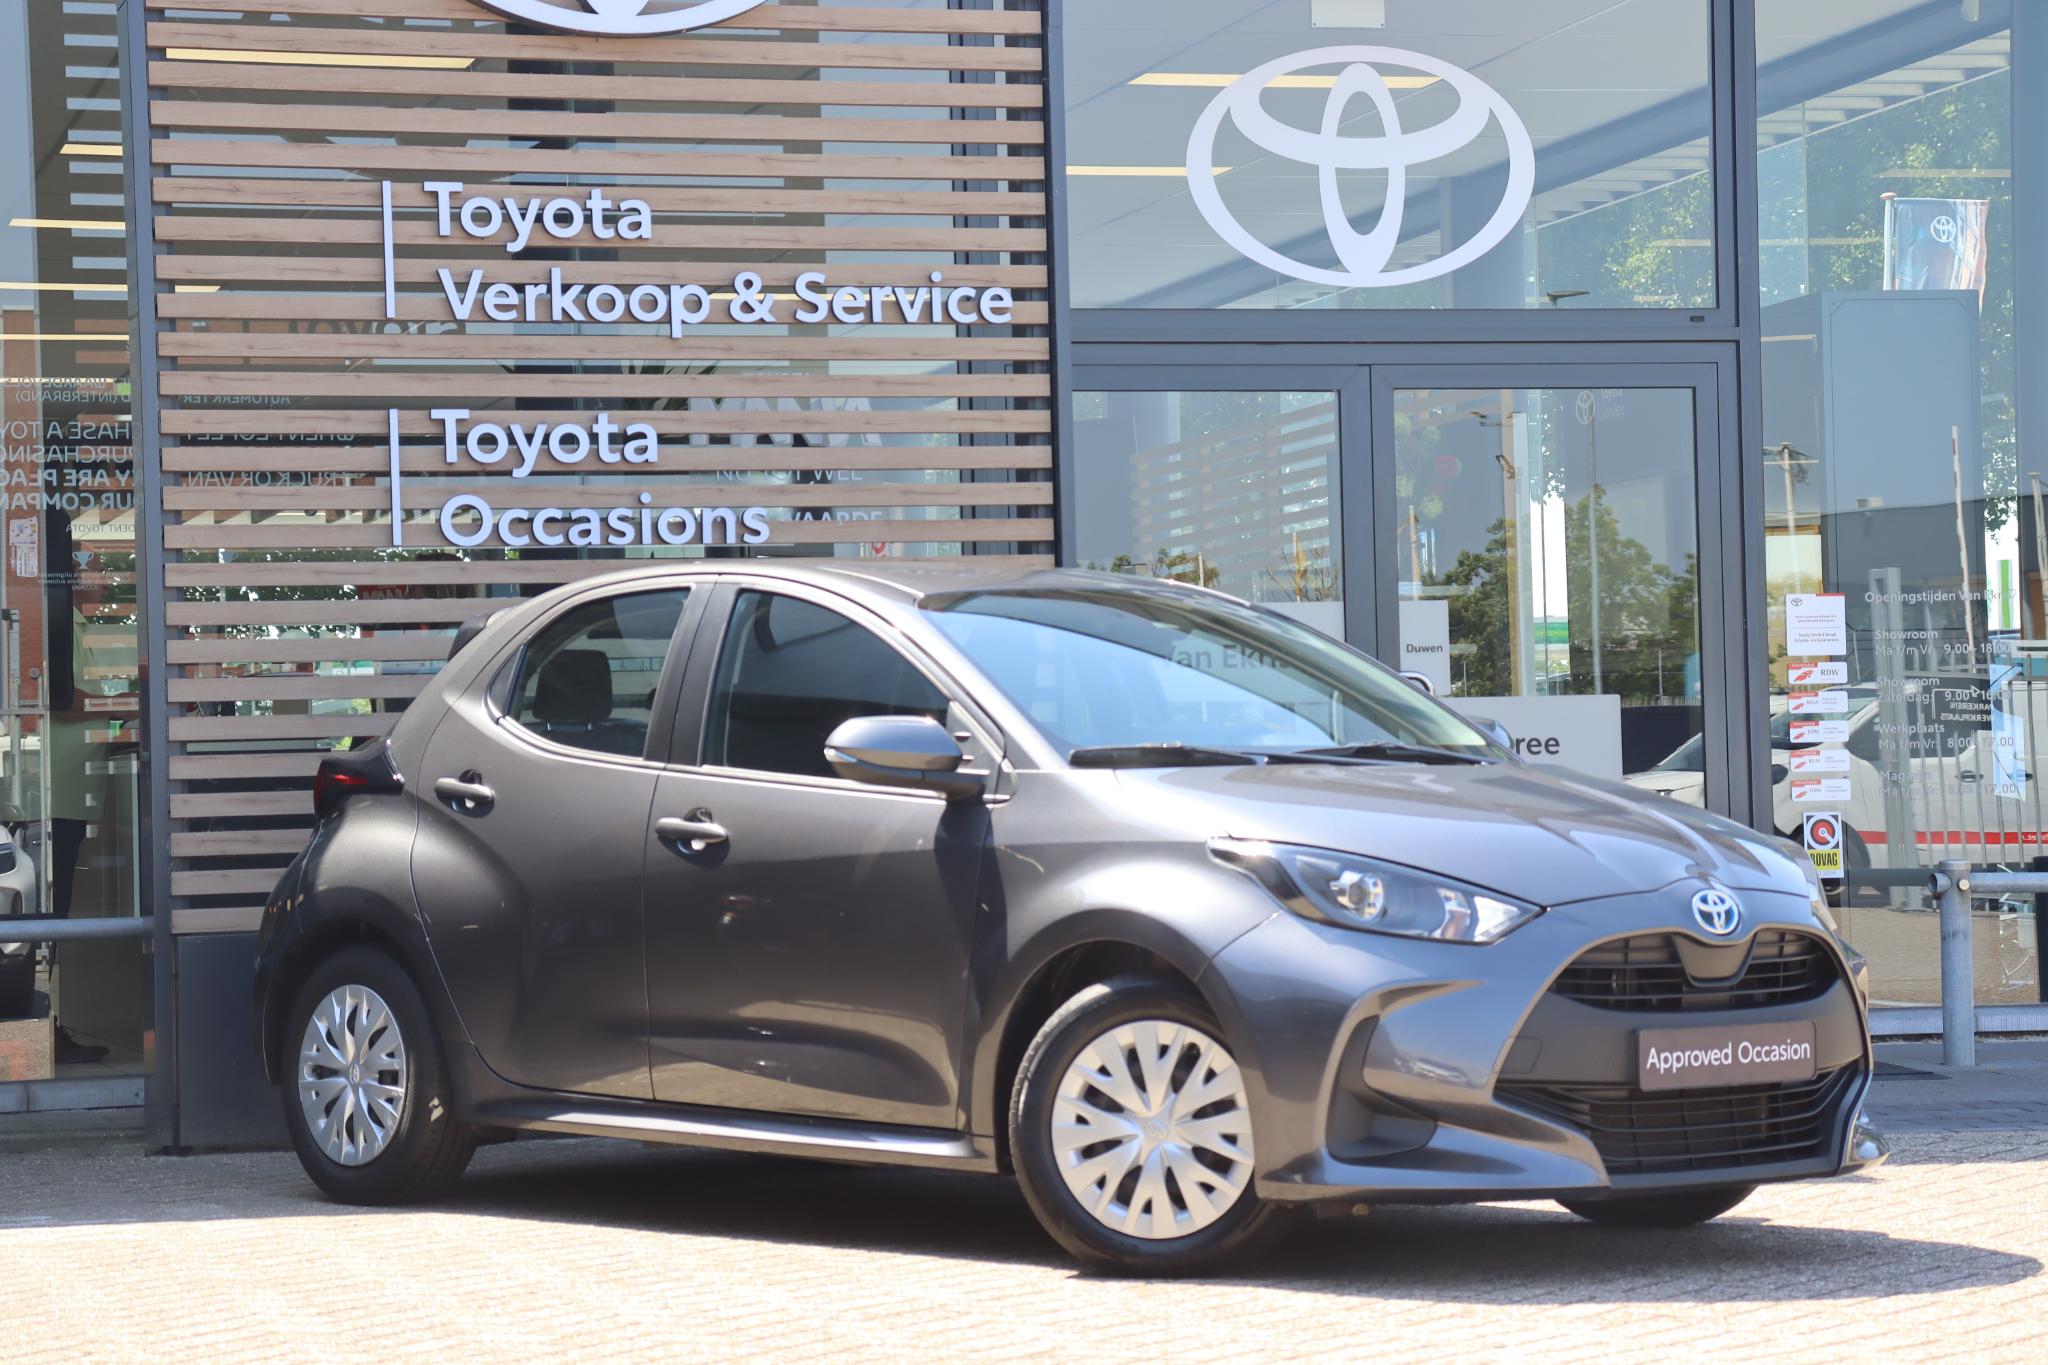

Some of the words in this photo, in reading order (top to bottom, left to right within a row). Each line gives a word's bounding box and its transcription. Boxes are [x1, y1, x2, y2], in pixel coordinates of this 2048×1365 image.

[423, 181, 653, 254] Toyota
[437, 267, 711, 338] Verkoop
[728, 271, 778, 324] &
[794, 271, 1015, 324] Service
[430, 408, 659, 478] Toyota
[439, 492, 771, 547] Occasions
[1406, 642, 1444, 654] Duwen
[1874, 629, 1938, 641] Showroom
[1876, 676, 1940, 687] Showroom
[1878, 722, 1945, 735] Werkplaats
[1646, 1040, 1733, 1075] Approved
[1737, 1038, 1811, 1064] Occasion
